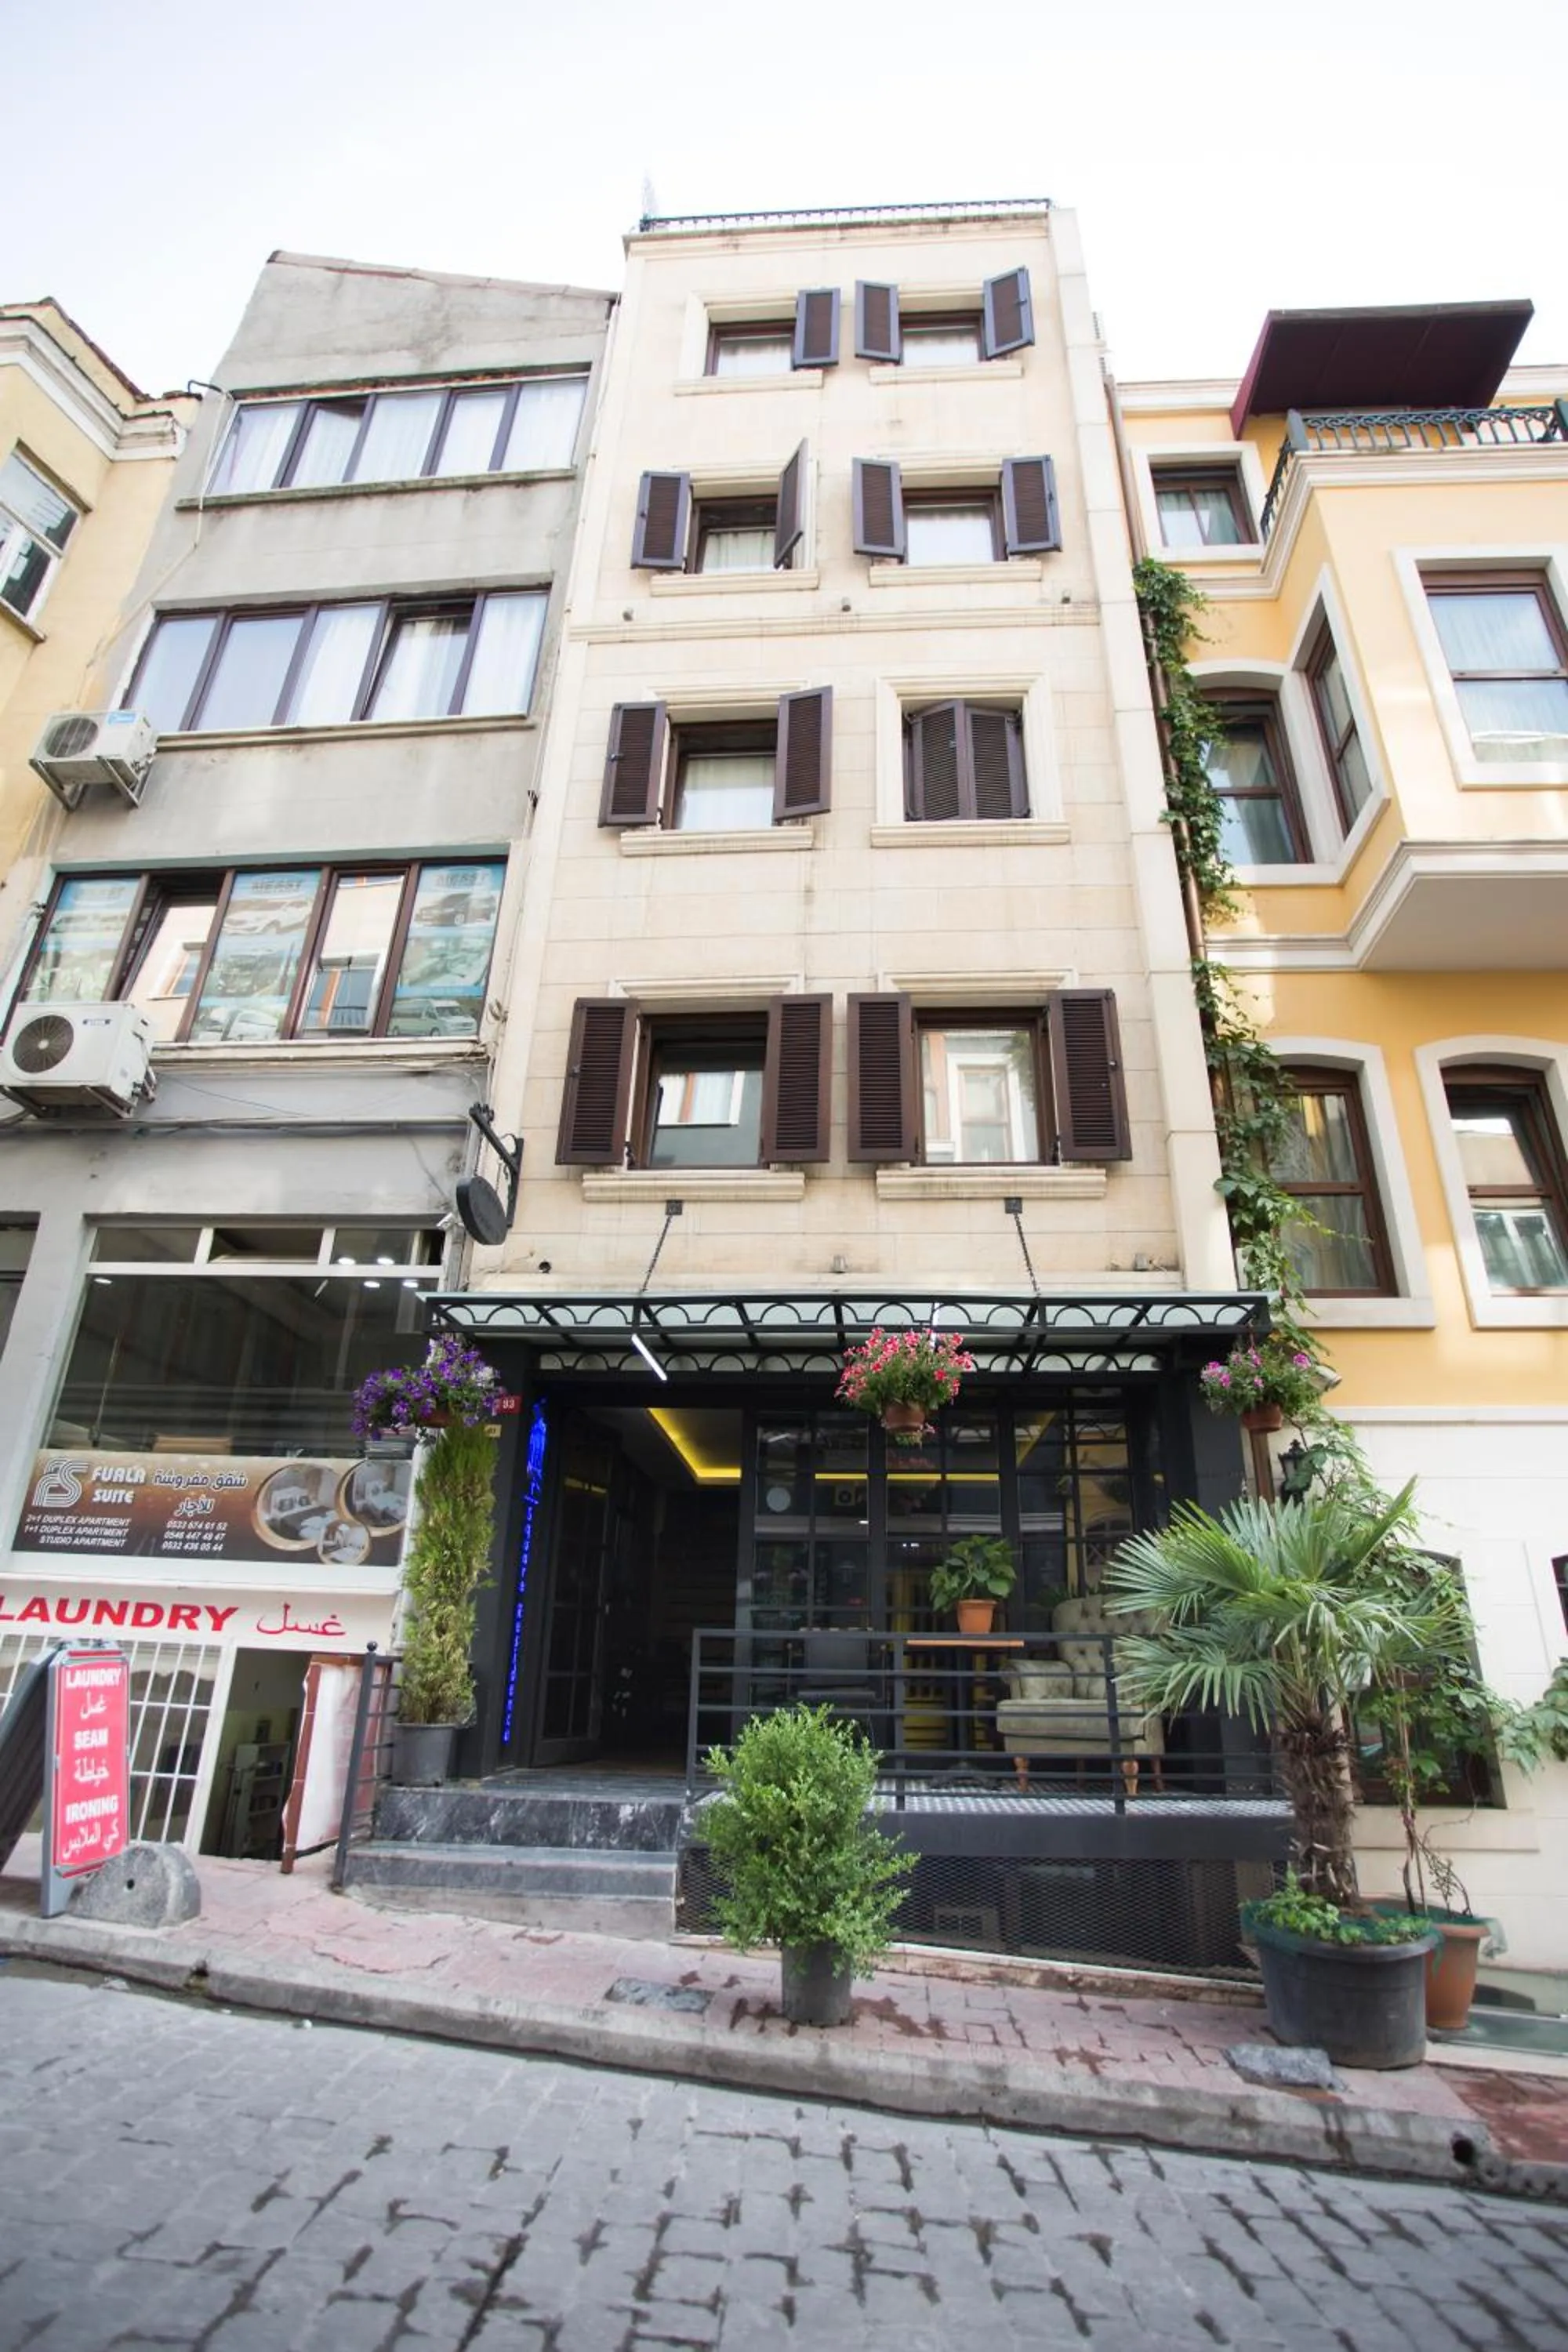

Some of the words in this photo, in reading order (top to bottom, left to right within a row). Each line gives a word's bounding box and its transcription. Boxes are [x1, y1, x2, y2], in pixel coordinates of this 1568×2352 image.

[39, 1525, 75, 1534] DUPLEX
[75, 1526, 129, 1537] APARTMENT
[42, 1514, 78, 1525] DUPLEX
[78, 1515, 132, 1526] APARTMENT
[39, 1535, 72, 1544] STUDIO
[72, 1537, 127, 1548] APARTMENT
[0, 1595, 238, 1632] LAUNDRY
[256, 1602, 346, 1635] غسل
[66, 1667, 122, 1690] LAUNDRY
[80, 1690, 107, 1719] غسل
[65, 1795, 118, 1824] IRONING
